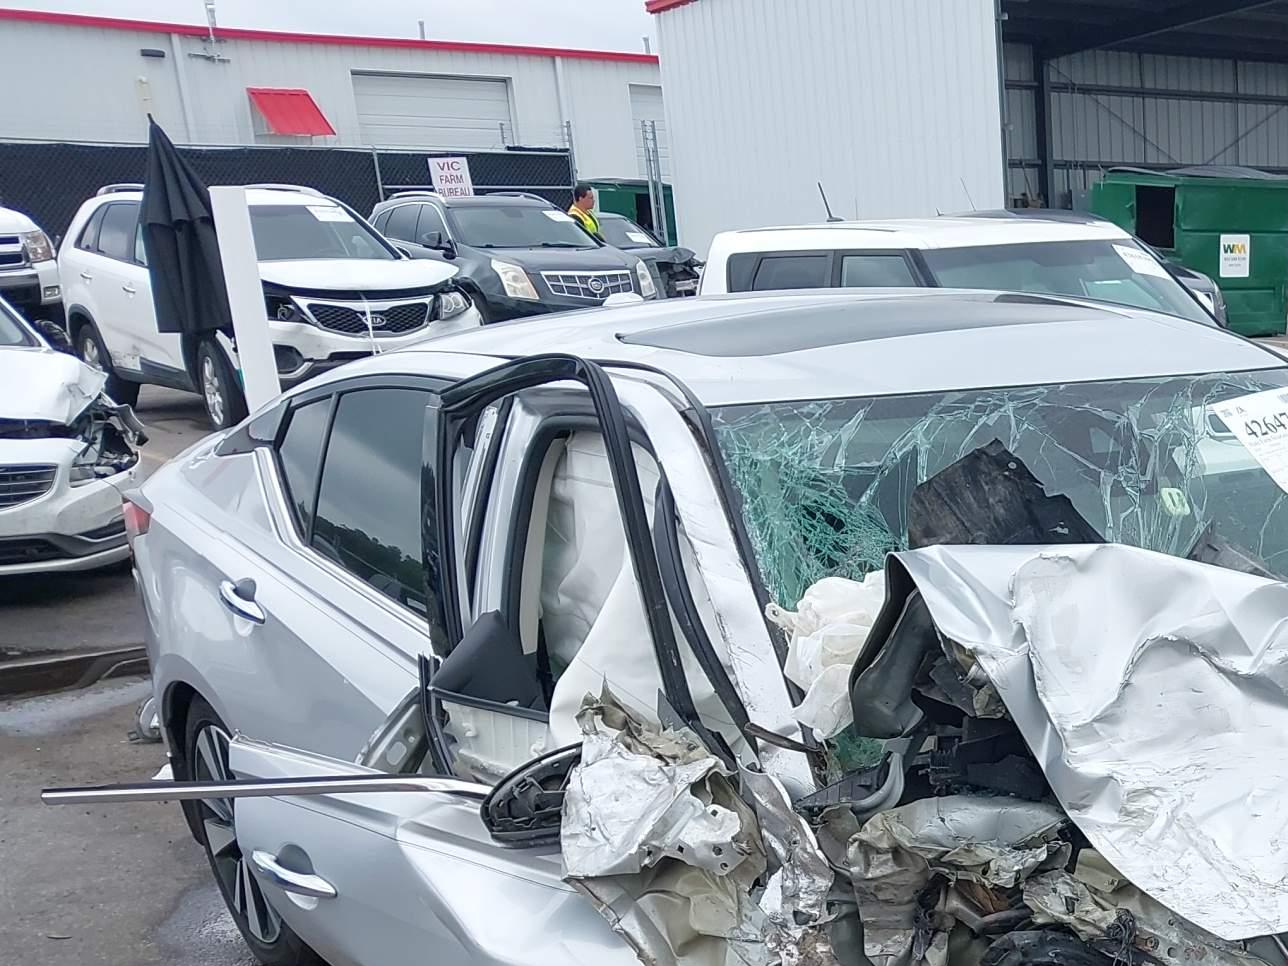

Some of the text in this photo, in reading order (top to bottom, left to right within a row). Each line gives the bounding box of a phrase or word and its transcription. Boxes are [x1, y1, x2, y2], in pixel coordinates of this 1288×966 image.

[437, 161, 461, 171] VIC
[440, 174, 464, 185] FARM
[1223, 243, 1247, 254] WM
